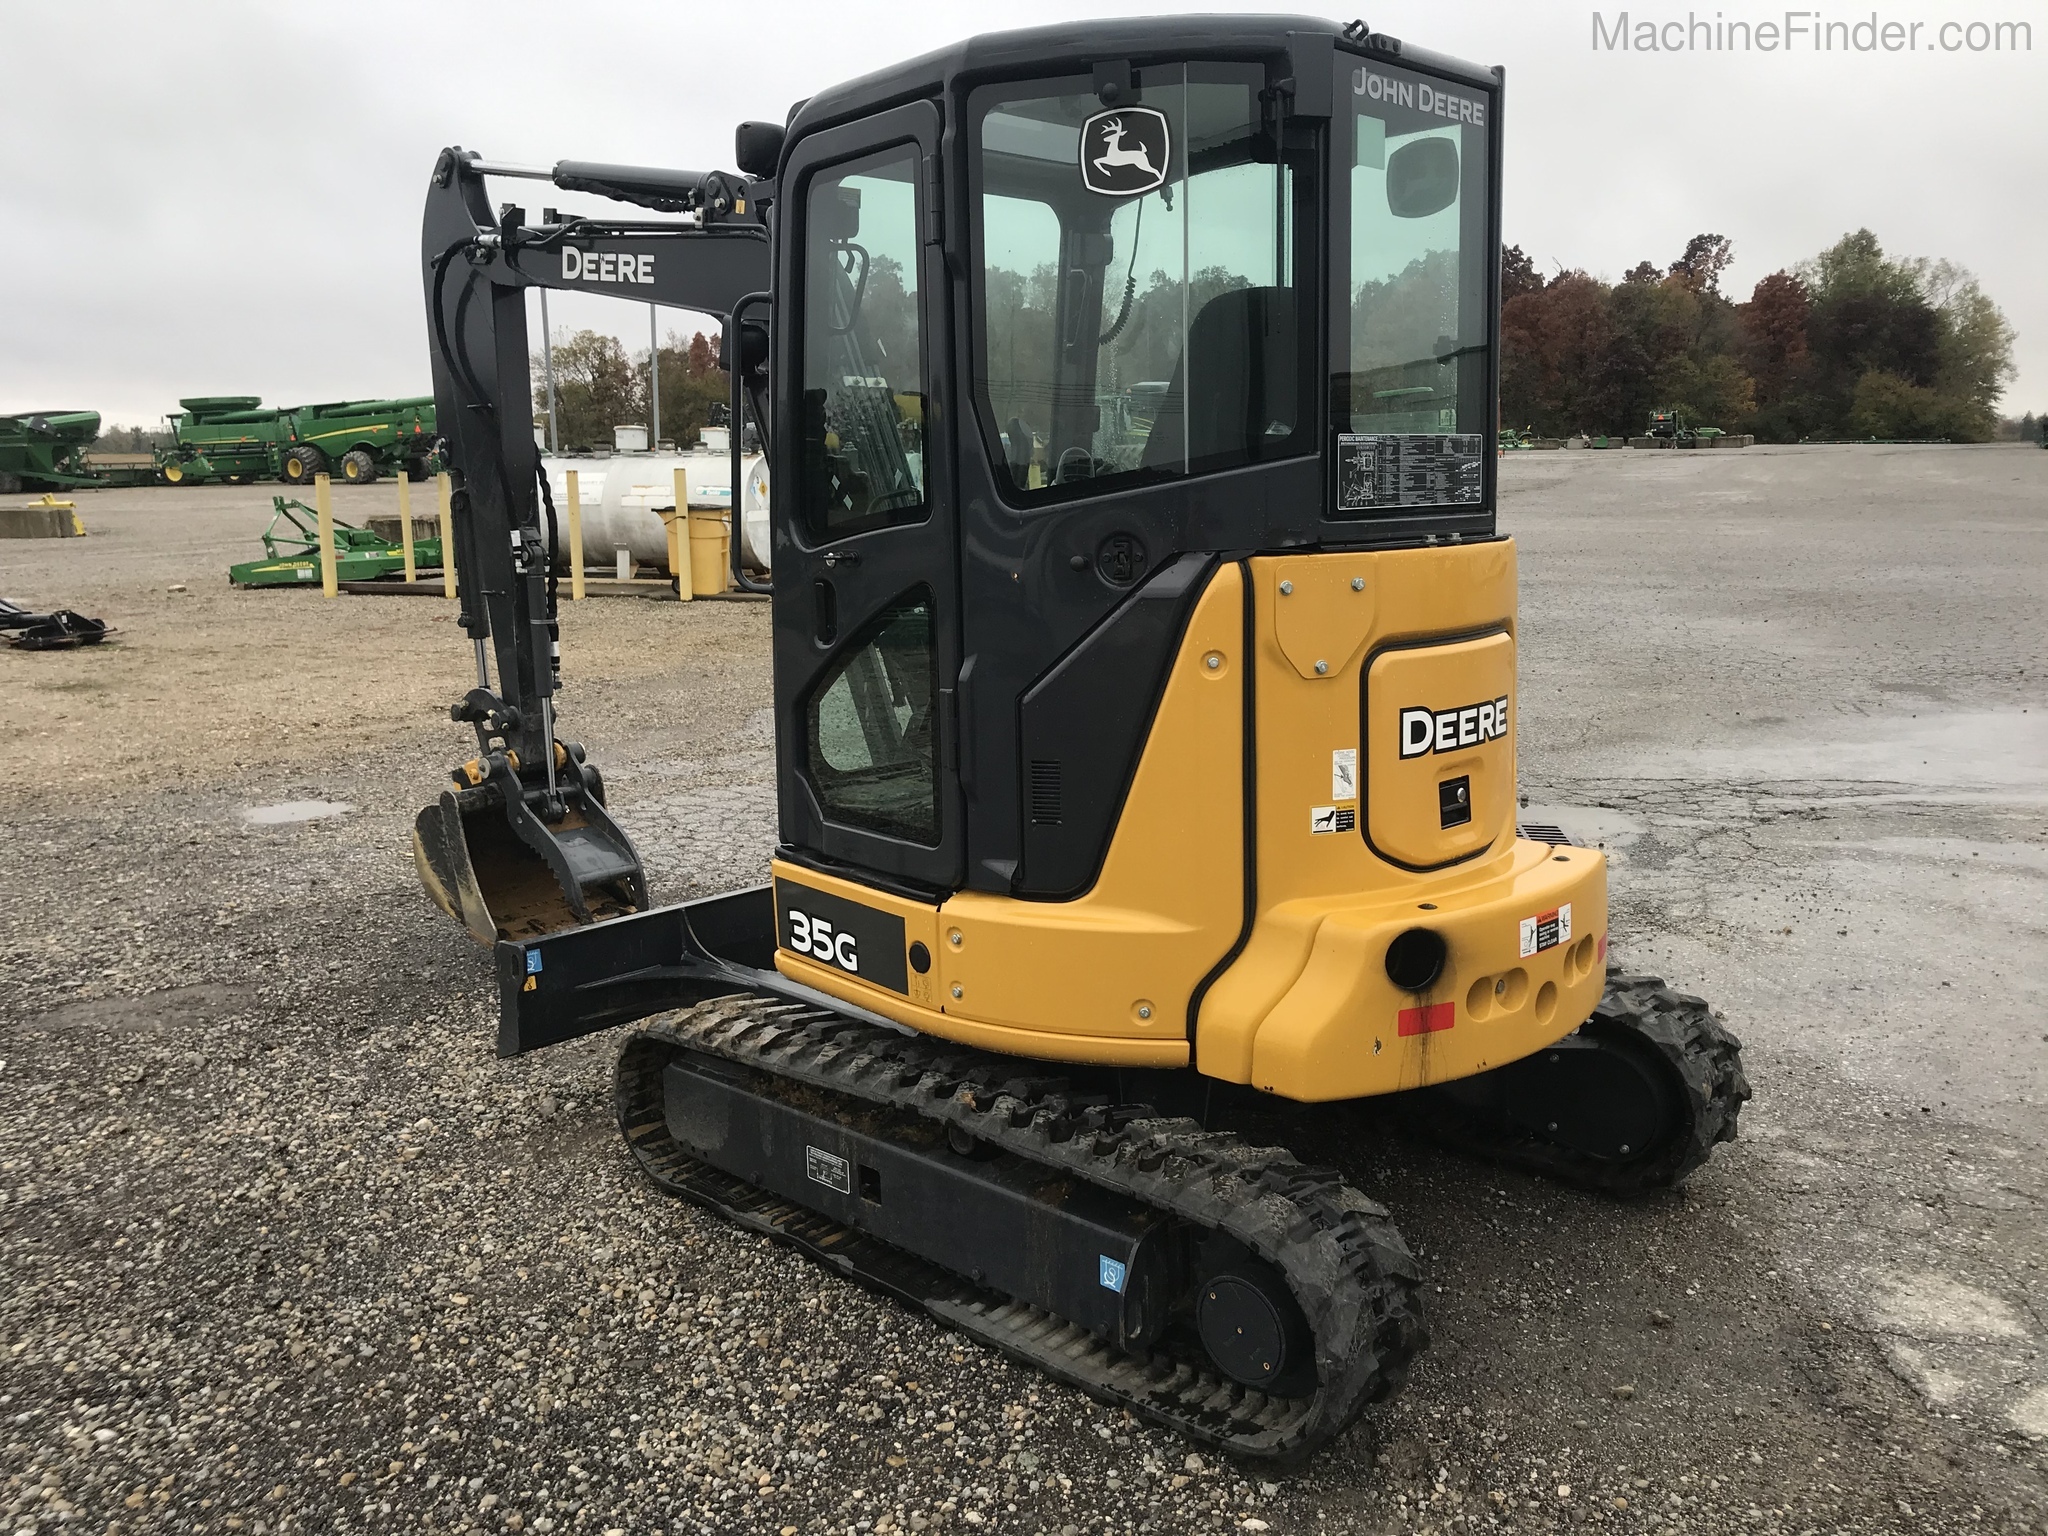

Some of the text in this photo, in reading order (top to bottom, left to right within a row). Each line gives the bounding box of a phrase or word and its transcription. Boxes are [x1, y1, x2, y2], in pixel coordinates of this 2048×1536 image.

[1353, 67, 1485, 127] JOHN DEERE
[562, 245, 655, 284] DEERE
[1400, 697, 1508, 758] DEERE
[788, 909, 859, 972] 35G
